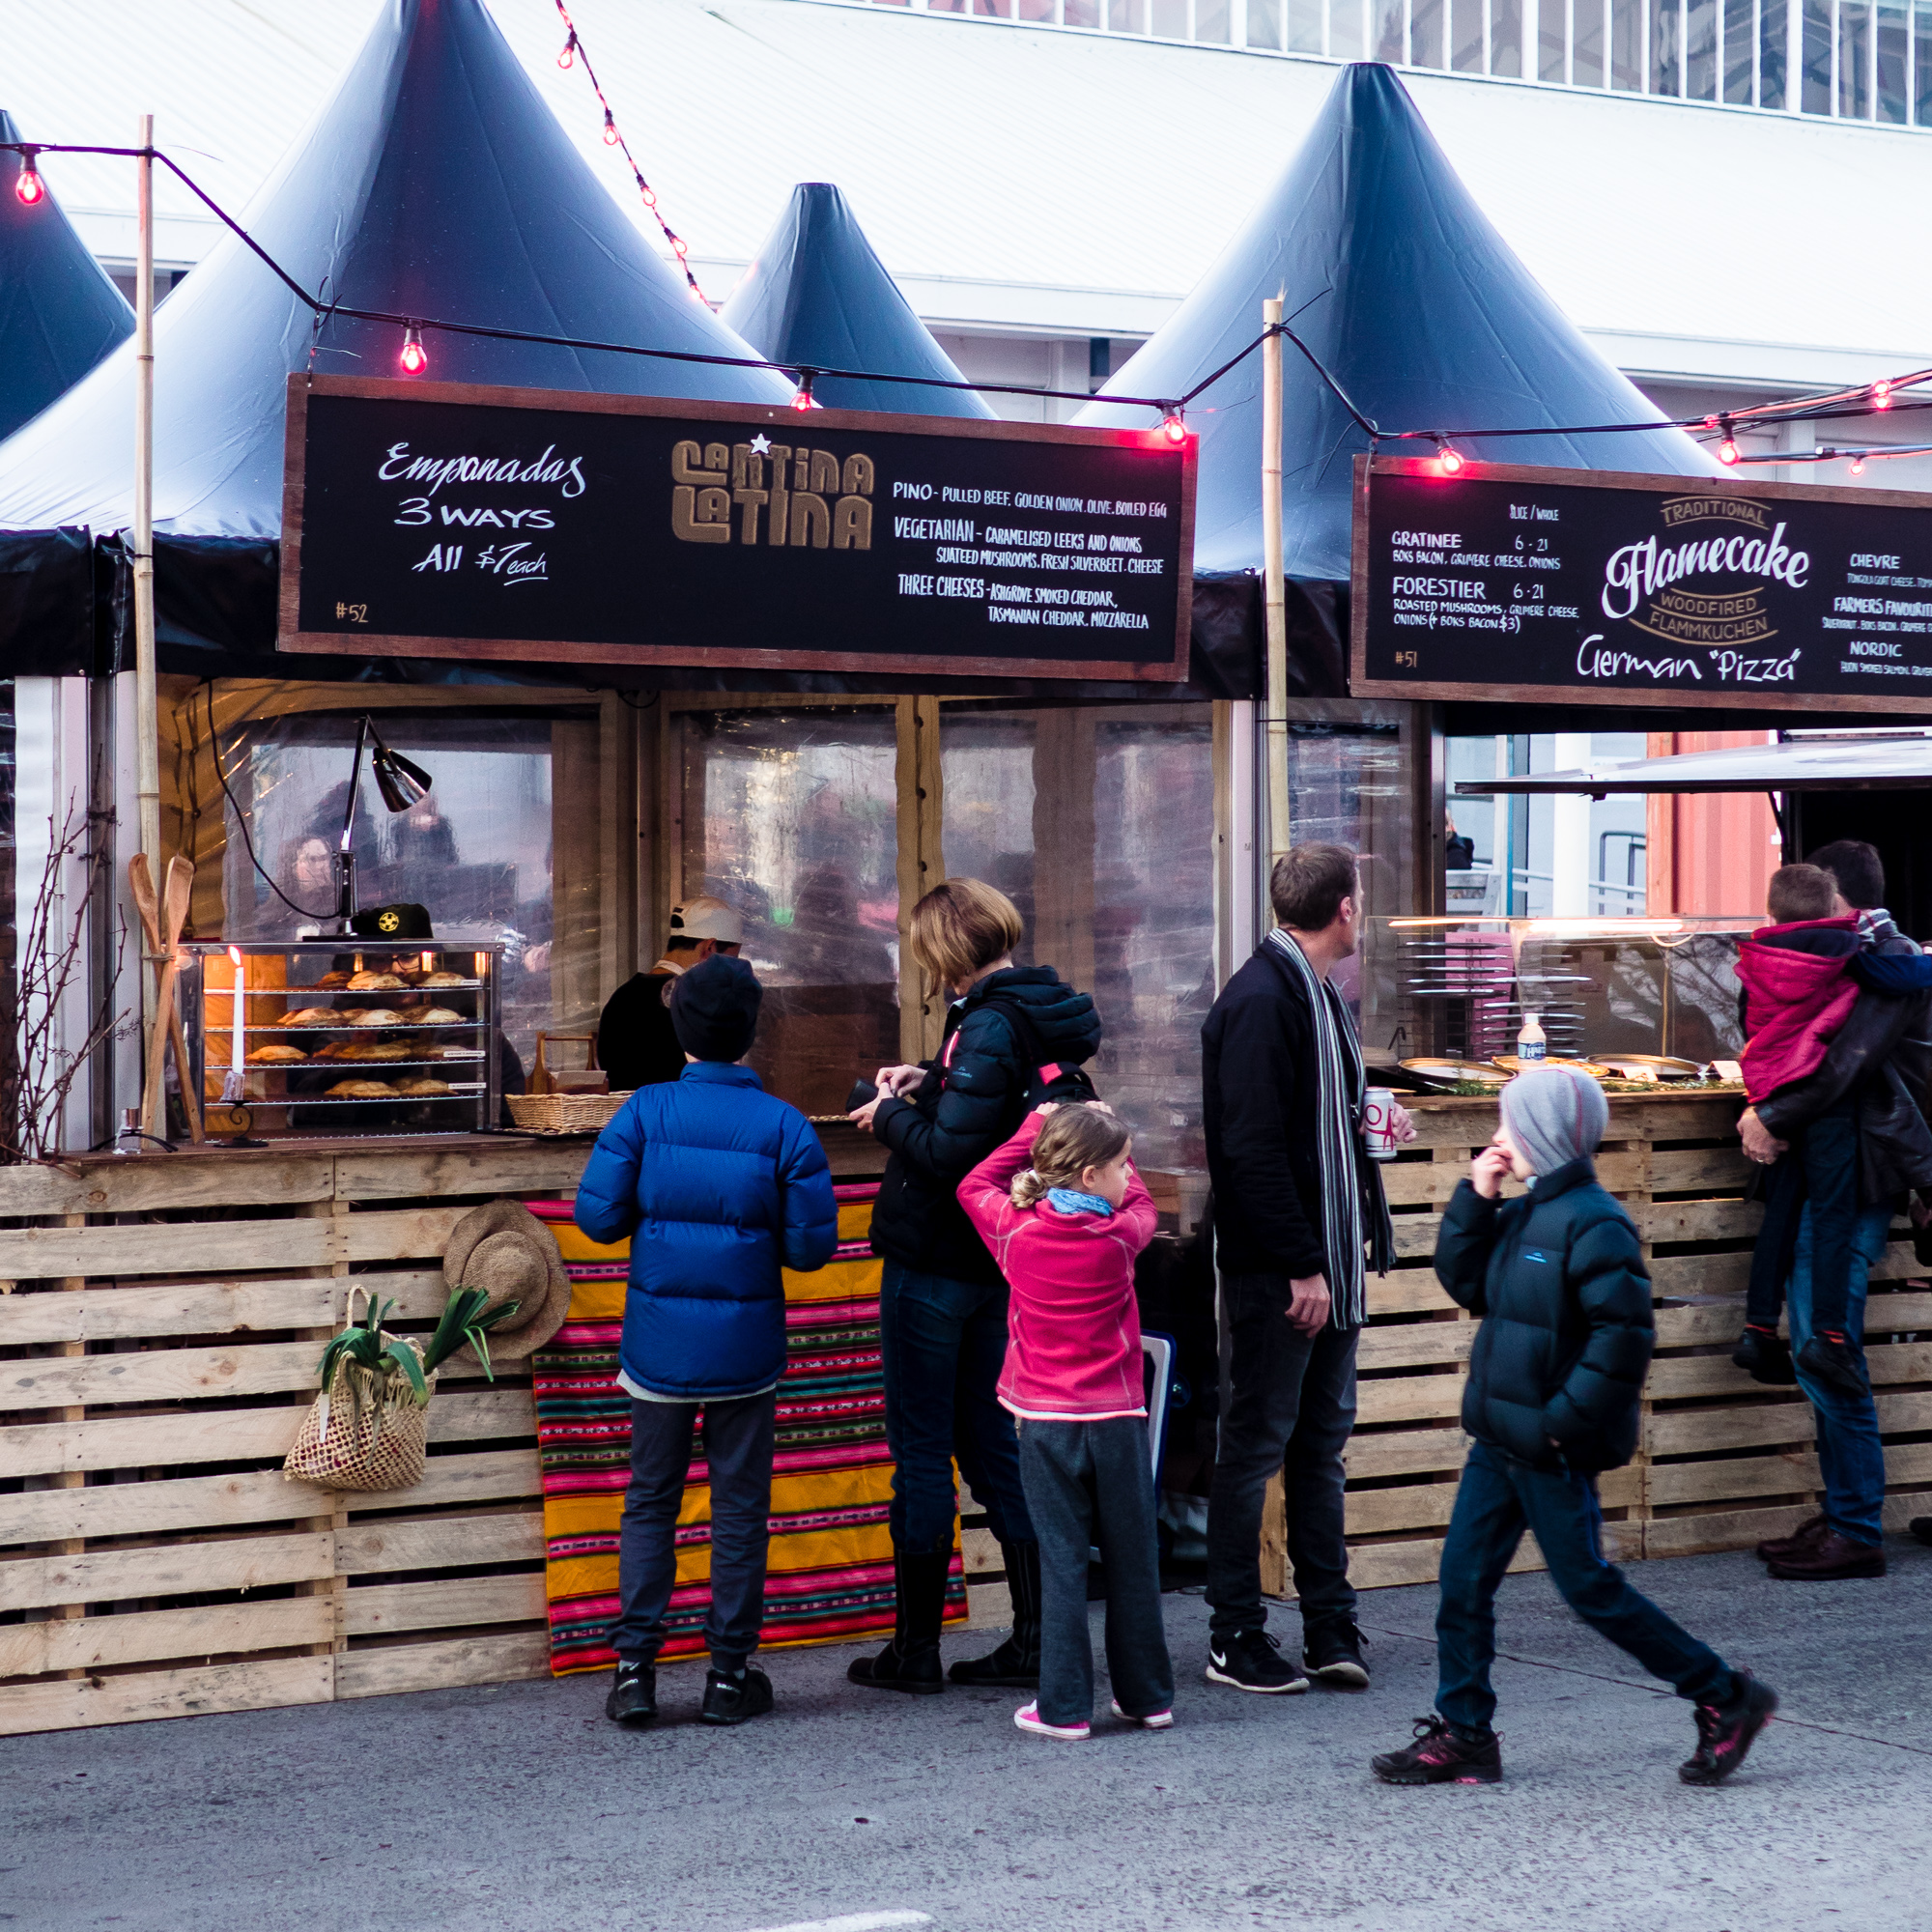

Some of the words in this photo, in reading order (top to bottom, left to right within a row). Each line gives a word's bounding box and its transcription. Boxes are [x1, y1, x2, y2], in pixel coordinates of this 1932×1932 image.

[378, 441, 586, 498] Empanadas
[393, 497, 432, 526] 3
[440, 504, 555, 529] WAYS
[942, 486, 981, 503] PULLED
[1014, 492, 1054, 512] GOLDEN
[1148, 502, 1168, 518] EGG
[1660, 500, 1766, 526] TRADITIONAL
[671, 485, 873, 551] LATINA
[894, 516, 975, 543] VEGETARIAN
[984, 526, 1052, 548] CARAMELISED
[1054, 532, 1085, 550] LEEKS
[1087, 534, 1108, 552] AND
[1109, 535, 1143, 554] ONIONS
[1391, 530, 1462, 549] GRATINEE
[1515, 534, 1524, 551] 6
[1536, 538, 1548, 552] 21
[411, 543, 464, 573] All
[1040, 554, 1069, 570] FRESH
[1127, 557, 1164, 574] CHEESE
[1528, 555, 1561, 570] ONIONS
[1849, 553, 1901, 570] CHEVRE
[1601, 522, 1809, 619] Flamecake
[897, 573, 934, 595] THREE
[936, 576, 984, 598] CHEESES
[1034, 587, 1069, 605] SMOKED
[1392, 576, 1487, 600] FORESTIER
[1513, 582, 1523, 599] 6
[1531, 583, 1544, 599] 21
[335, 602, 369, 623] #52
[1393, 598, 1438, 612] ROASTED
[1661, 593, 1757, 615] WOODFIRED
[1833, 596, 1884, 614] FARMERS
[987, 606, 1040, 625] TASMANIAN
[1090, 611, 1150, 629] MOZZARELLA
[1439, 615, 1465, 628] BOKS
[1468, 616, 1499, 630] BACON
[1649, 611, 1768, 640] FLAMMKUCHEN
[1395, 650, 1418, 668] #51
[1577, 634, 1702, 680] German
[1849, 640, 1903, 658] NORDIC
